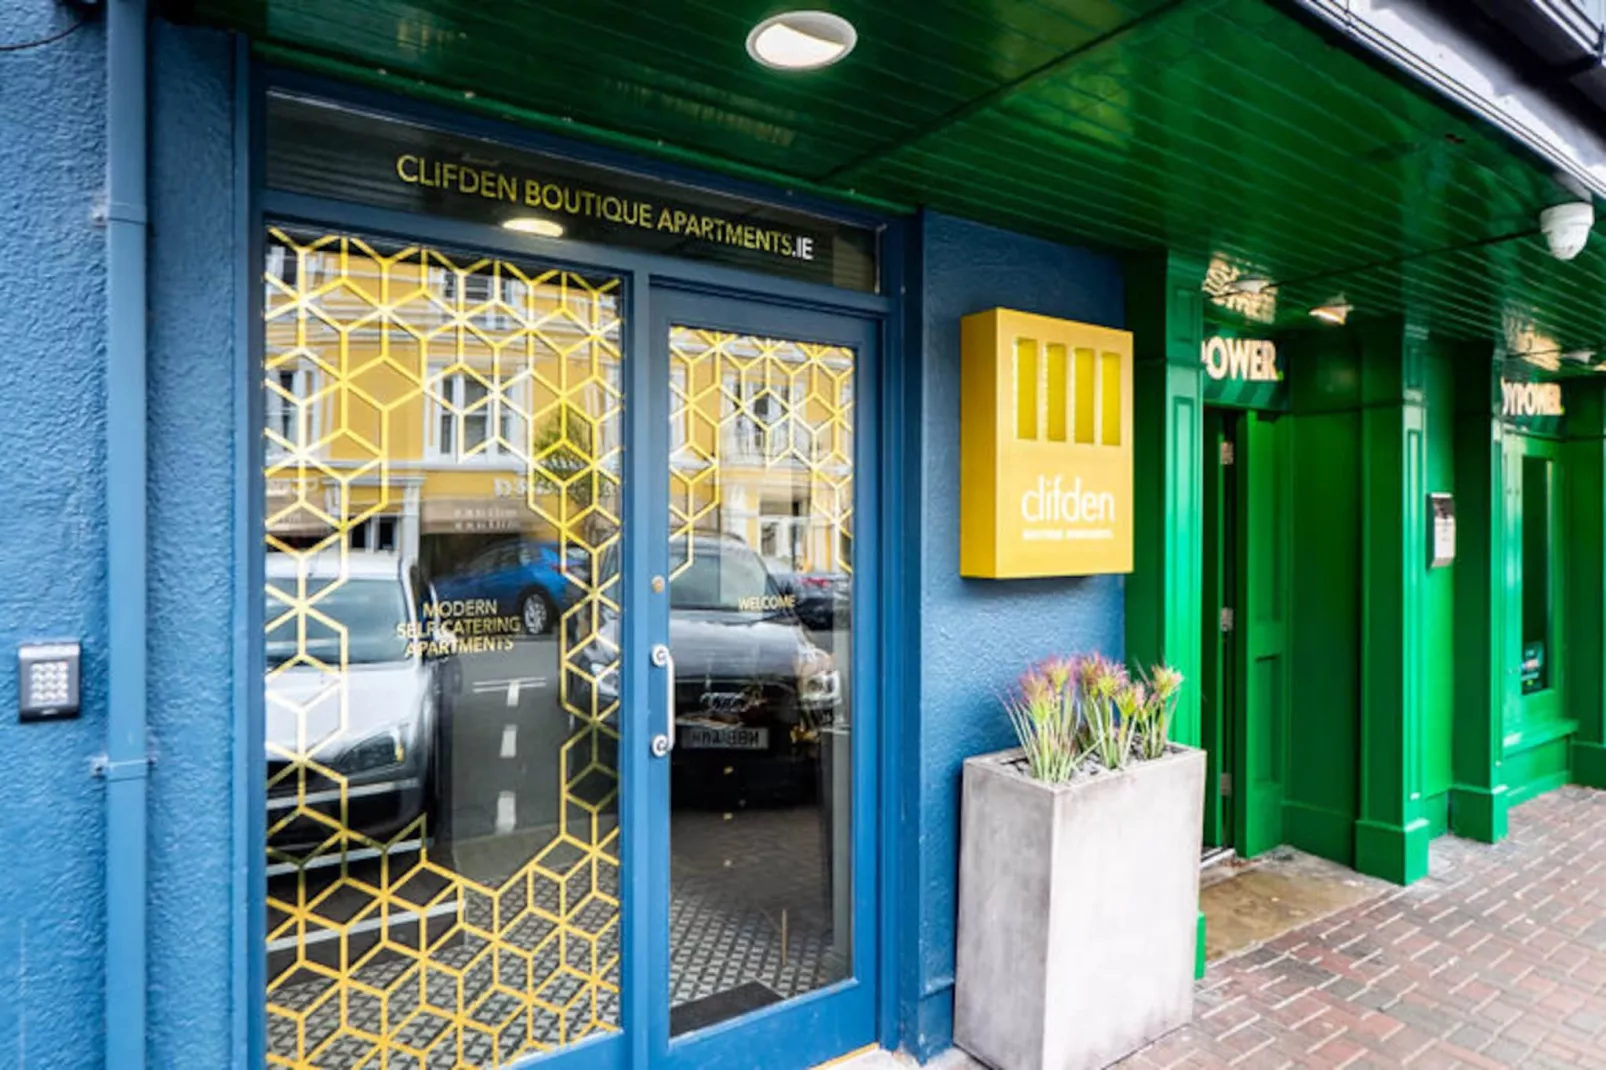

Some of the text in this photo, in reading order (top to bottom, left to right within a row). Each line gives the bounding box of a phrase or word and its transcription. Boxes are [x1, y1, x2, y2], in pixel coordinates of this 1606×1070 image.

[395, 154, 517, 202] CLIFDEN
[524, 179, 653, 229] BOUTIQUE
[1021, 473, 1116, 523] clifden
[422, 599, 498, 618] MODERN
[737, 594, 797, 611] WELCOME
[404, 636, 515, 659] APARTMENTS
